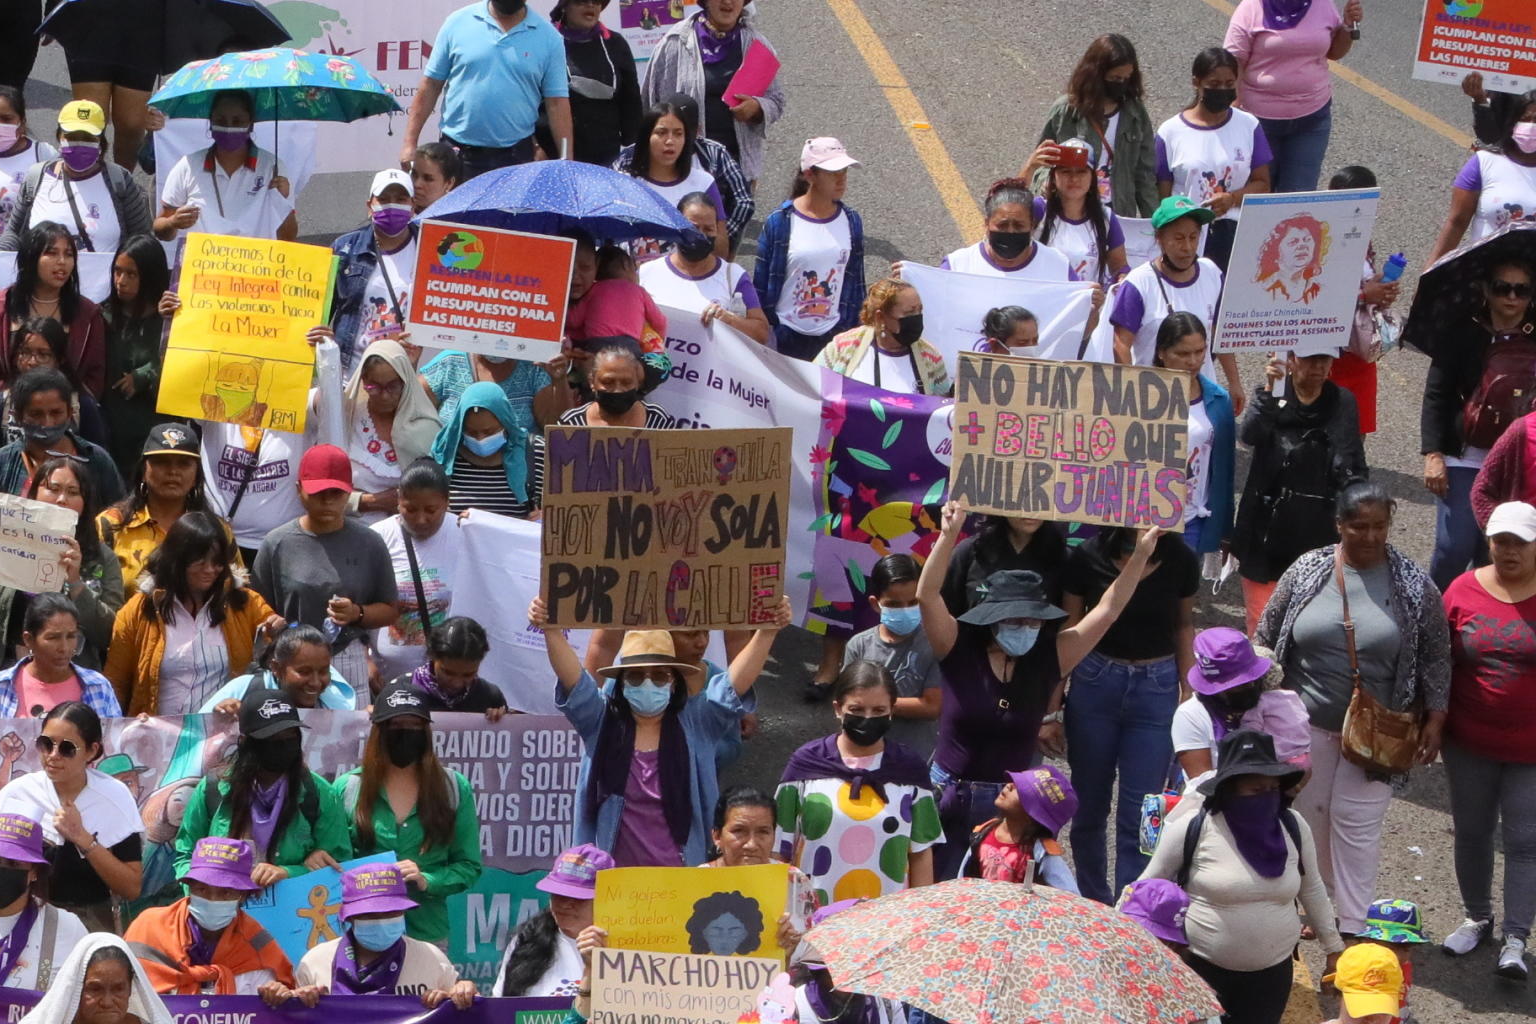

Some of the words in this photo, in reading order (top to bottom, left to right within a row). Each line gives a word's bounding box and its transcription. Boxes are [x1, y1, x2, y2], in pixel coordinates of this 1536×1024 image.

[1432, 38, 1511, 58] PRESUPUESTO
[1497, 35, 1523, 46] CON
[1430, 51, 1451, 63] LAS
[201, 239, 264, 262] Queremos
[275, 266, 294, 280] de
[495, 272, 513, 283] LA
[193, 276, 220, 295] Ley
[283, 283, 320, 300] contra
[427, 280, 499, 299] ¡CUMPLAN
[501, 288, 531, 302] CON
[533, 294, 548, 305] EL
[219, 298, 275, 314] violencias
[283, 301, 315, 319] hacia
[425, 295, 518, 317] PRESUPUESTO
[520, 308, 555, 322] PARA
[236, 316, 282, 339] Mujer
[423, 311, 447, 324] LAS
[449, 314, 516, 333] MUJERES!
[1221, 329, 1284, 339] INTELECTUALES
[1285, 328, 1301, 336] DEL
[1301, 326, 1345, 335] ASESINATO
[1265, 320, 1282, 328] SON
[1284, 319, 1299, 327] LOS
[1299, 317, 1337, 326] AUTORES
[1220, 341, 1230, 349] DE
[1232, 340, 1256, 348] BERTA
[670, 362, 699, 383] de
[707, 369, 723, 390] la
[729, 377, 770, 411] Mujer
[958, 356, 1016, 406] NO
[1026, 361, 1086, 410] HAY
[993, 411, 1116, 462] BELLO
[1124, 420, 1188, 469] QUE
[219, 464, 229, 477] DE
[950, 453, 1055, 512] AULLAR
[1054, 461, 1187, 528] JUNTAS
[17, 507, 35, 524] te
[543, 504, 599, 556] HOY
[604, 495, 653, 560] NO
[653, 490, 713, 557] VOY
[2, 529, 18, 538] es
[24, 529, 34, 540] la
[547, 562, 619, 624] POR
[623, 570, 658, 625] LA
[665, 560, 781, 626] CALLE
[498, 762, 512, 790] Y
[599, 951, 720, 988] MARCHO
[726, 960, 777, 990] HOY
[603, 986, 637, 1005] con
[643, 990, 672, 1010] mis
[679, 993, 752, 1014] amigas
